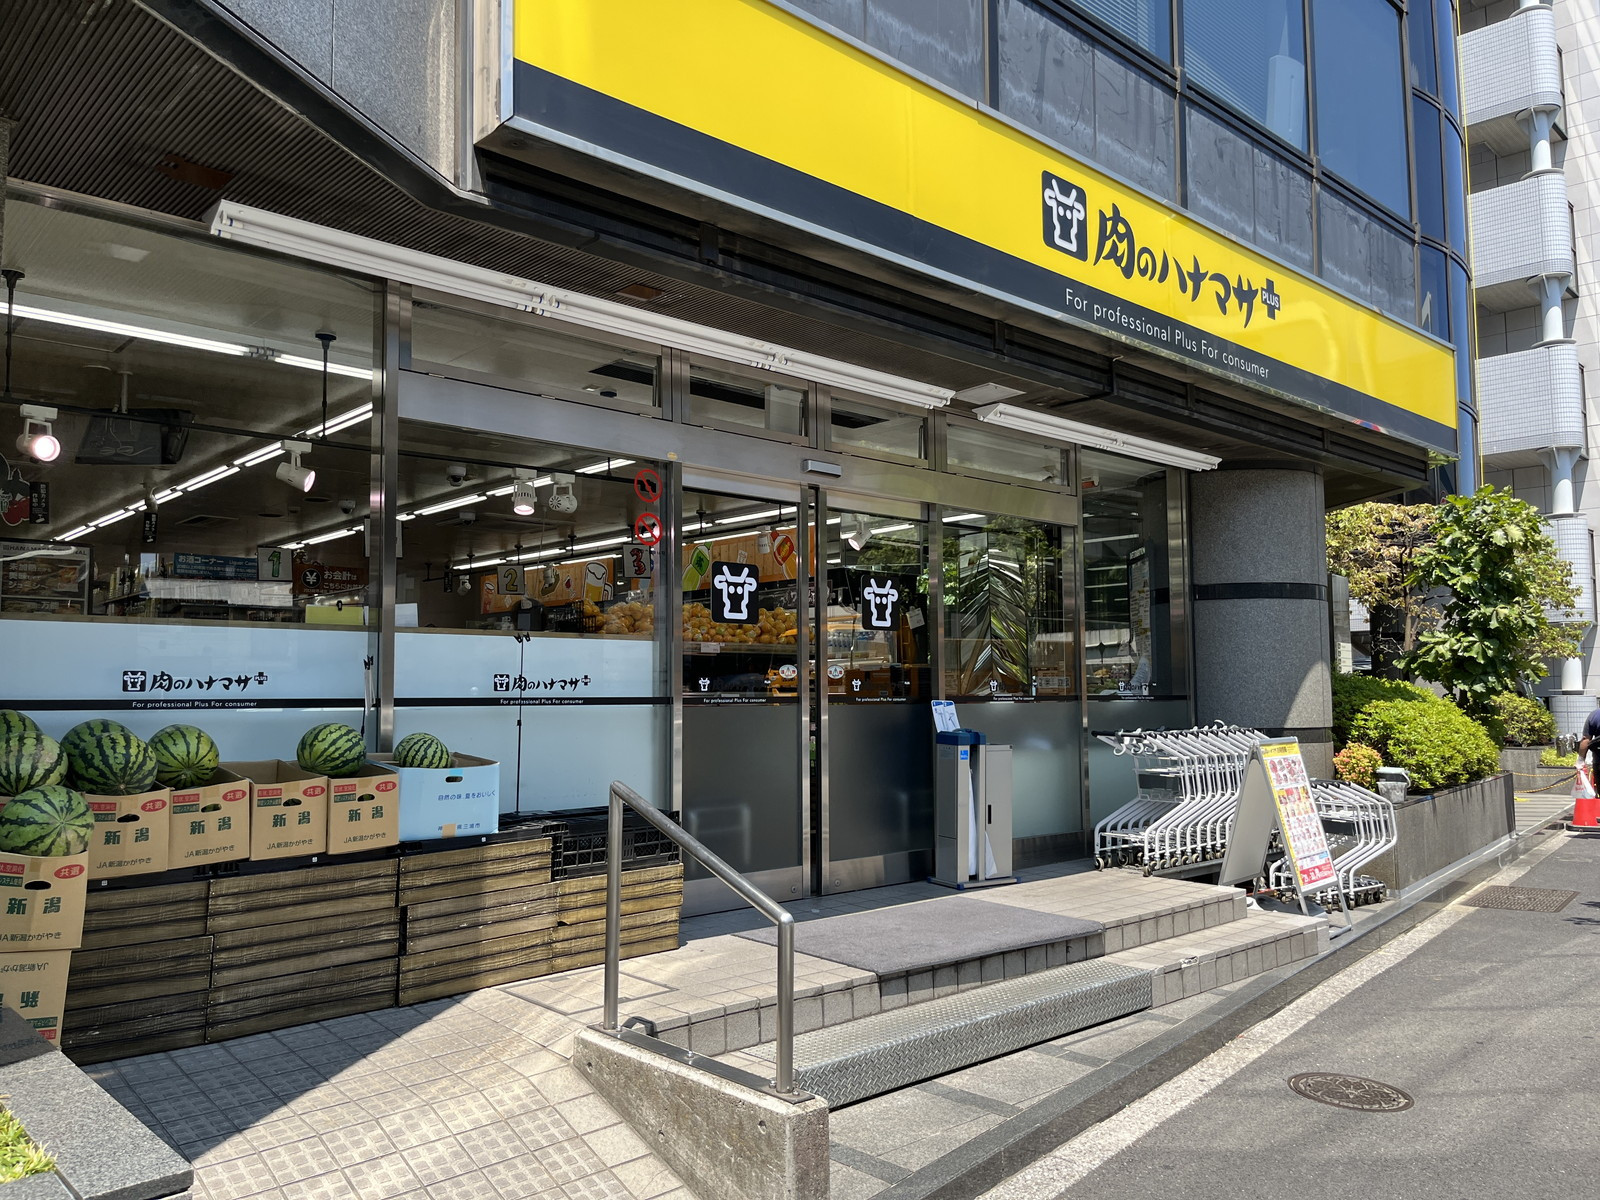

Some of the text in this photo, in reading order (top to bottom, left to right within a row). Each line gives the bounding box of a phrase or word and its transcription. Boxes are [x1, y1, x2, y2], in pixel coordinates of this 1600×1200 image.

[1094, 203, 1259, 328] 肉のハナマサ
[1262, 290, 1280, 308] PLUS
[1065, 288, 1269, 379] For professional Plus For consumer
[268, 550, 281, 578] 1
[630, 548, 646, 576] 3
[504, 568, 518, 592] 2
[149, 671, 253, 692] 肉のハナマサ
[511, 674, 580, 692] 肉のハナマサ
[272, 811, 310, 828] 新潟
[348, 805, 384, 822] 新潟
[190, 816, 231, 835] 新潟
[437, 822, 481, 831] 神県三浦市
[104, 827, 150, 845] 新潟
[267, 838, 313, 850] JA新潟かがやき
[343, 832, 386, 843] JA新潟かがやき
[184, 844, 235, 858] JA新潟かがやき
[96, 857, 152, 869] JA新潟かがやき
[6, 897, 62, 914] 新潟
